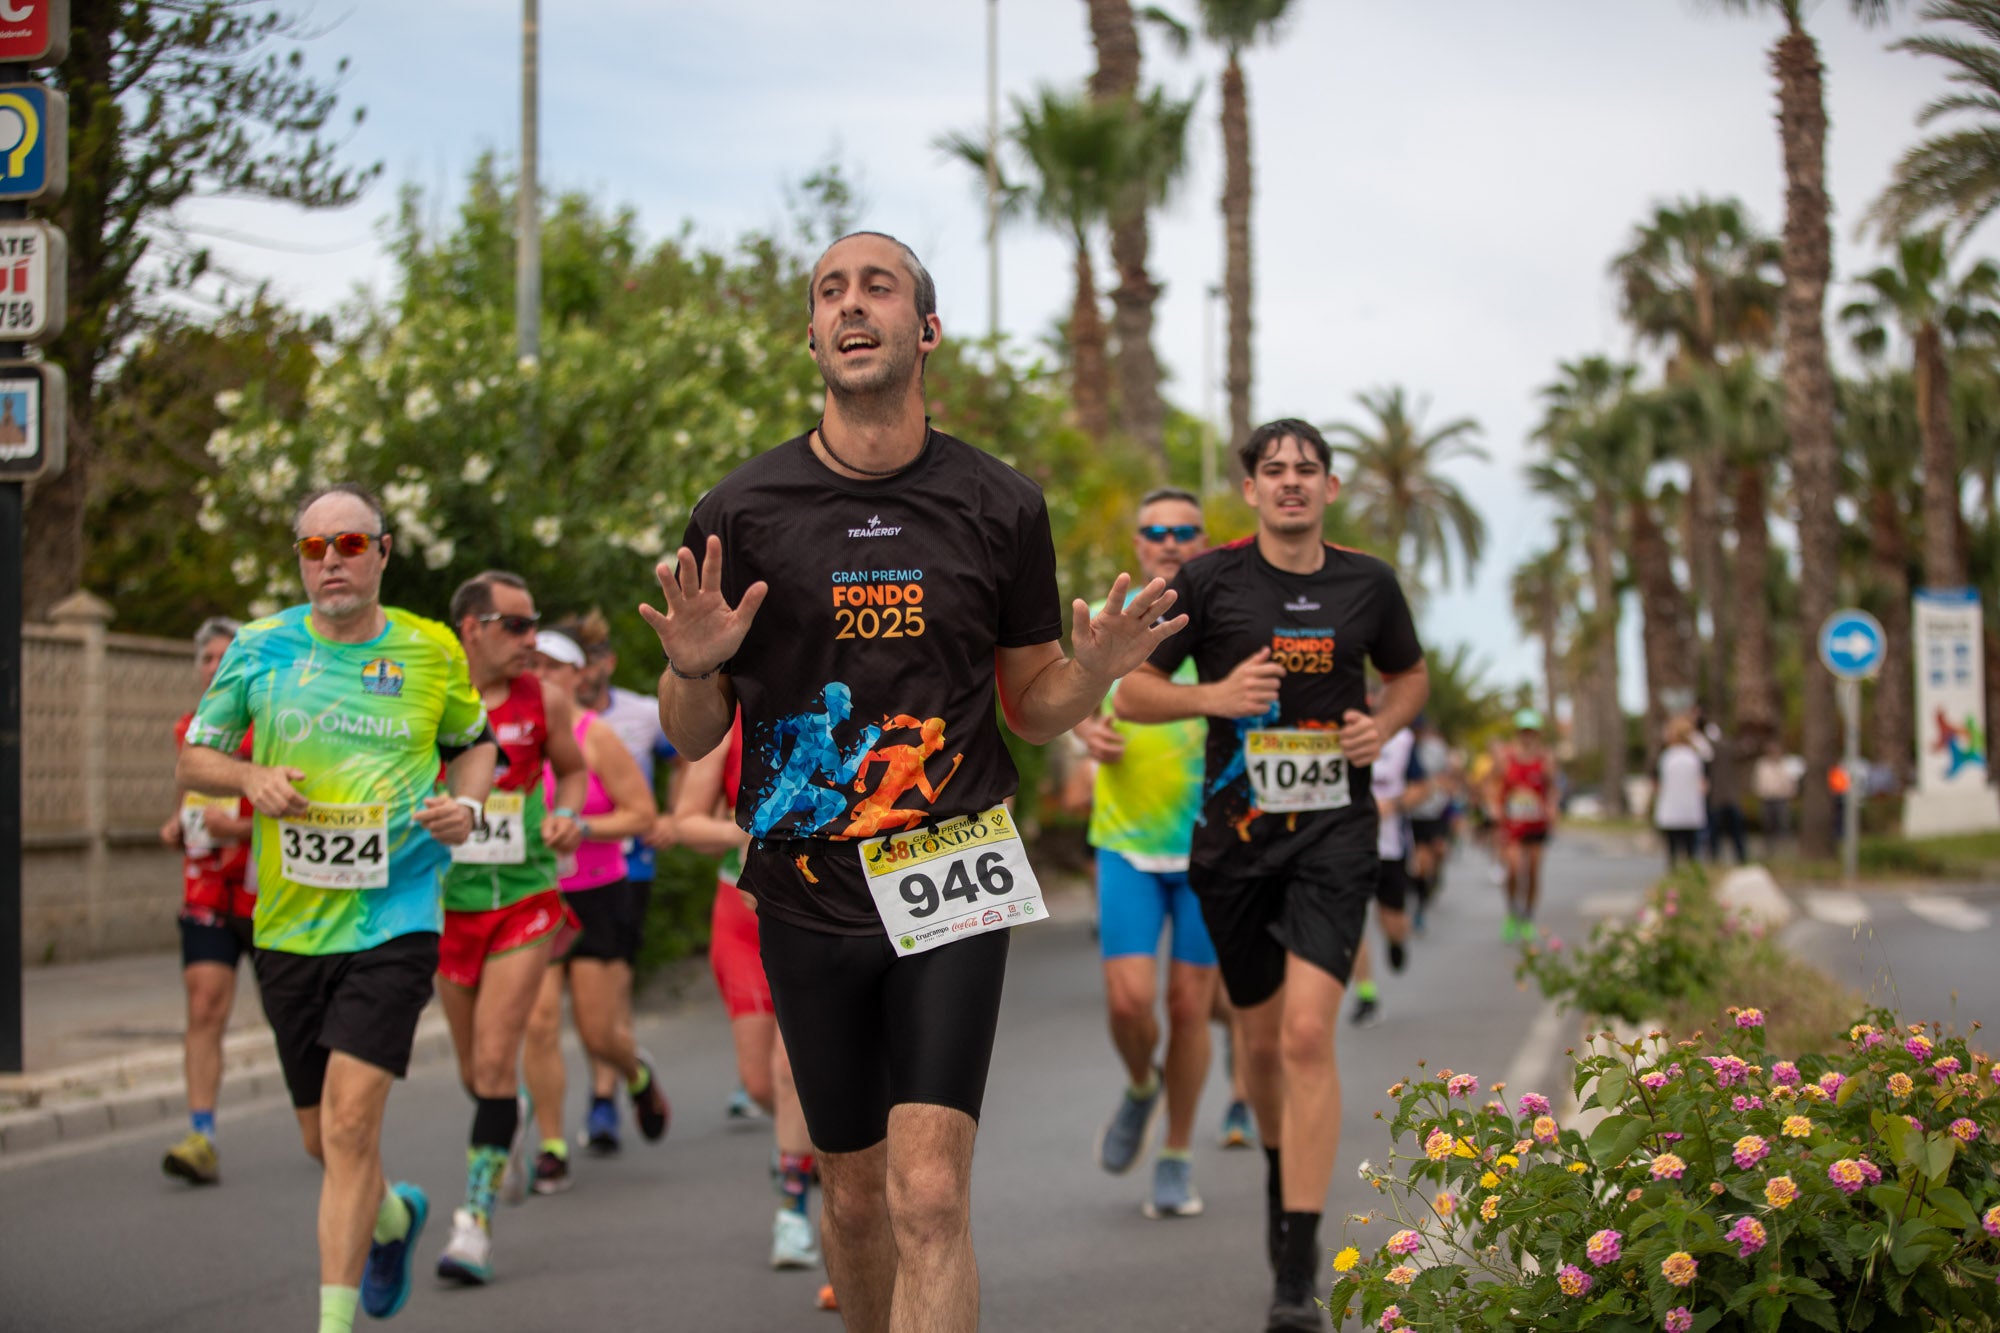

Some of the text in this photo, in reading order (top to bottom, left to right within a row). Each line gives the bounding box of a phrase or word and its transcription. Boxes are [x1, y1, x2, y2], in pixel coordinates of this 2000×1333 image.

[848, 527, 902, 538] TEAMERGY
[832, 569, 923, 582] GRAN PREMIO
[832, 584, 924, 607] FONDO
[835, 607, 925, 640] 2025
[1272, 637, 1335, 653] FONDO
[319, 713, 412, 740] OMNIA
[1254, 758, 1344, 790] 1043
[284, 828, 383, 866] 3324
[886, 824, 988, 864] 38 FONDO
[899, 852, 1015, 919] 946
[915, 926, 949, 942] Cruzcampo
